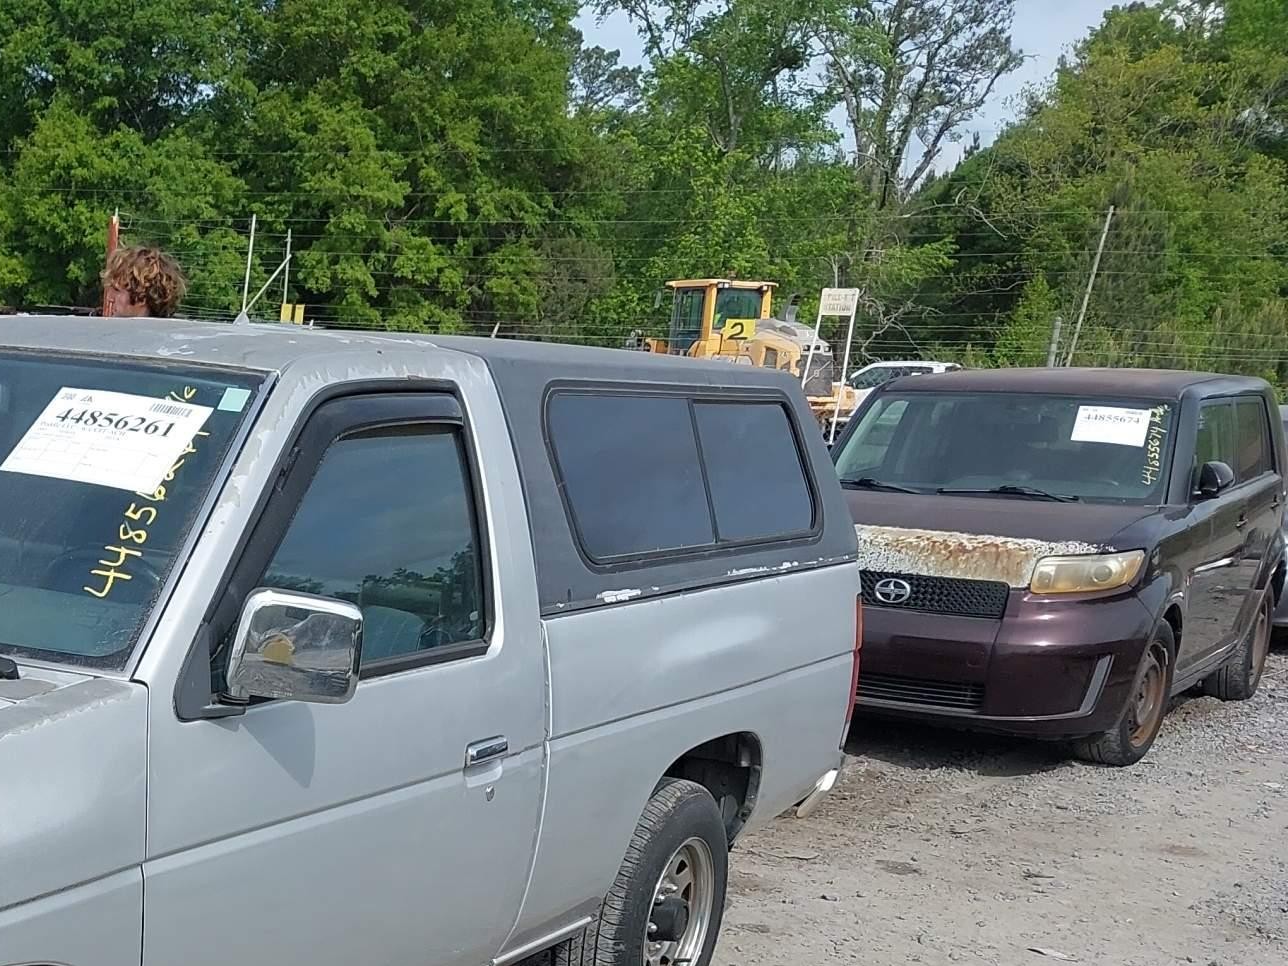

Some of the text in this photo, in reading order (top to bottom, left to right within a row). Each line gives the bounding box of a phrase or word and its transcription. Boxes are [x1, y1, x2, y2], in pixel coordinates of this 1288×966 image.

[727, 321, 749, 340] 2
[55, 407, 175, 438] 44856261
[1083, 413, 1140, 425] 44855674
